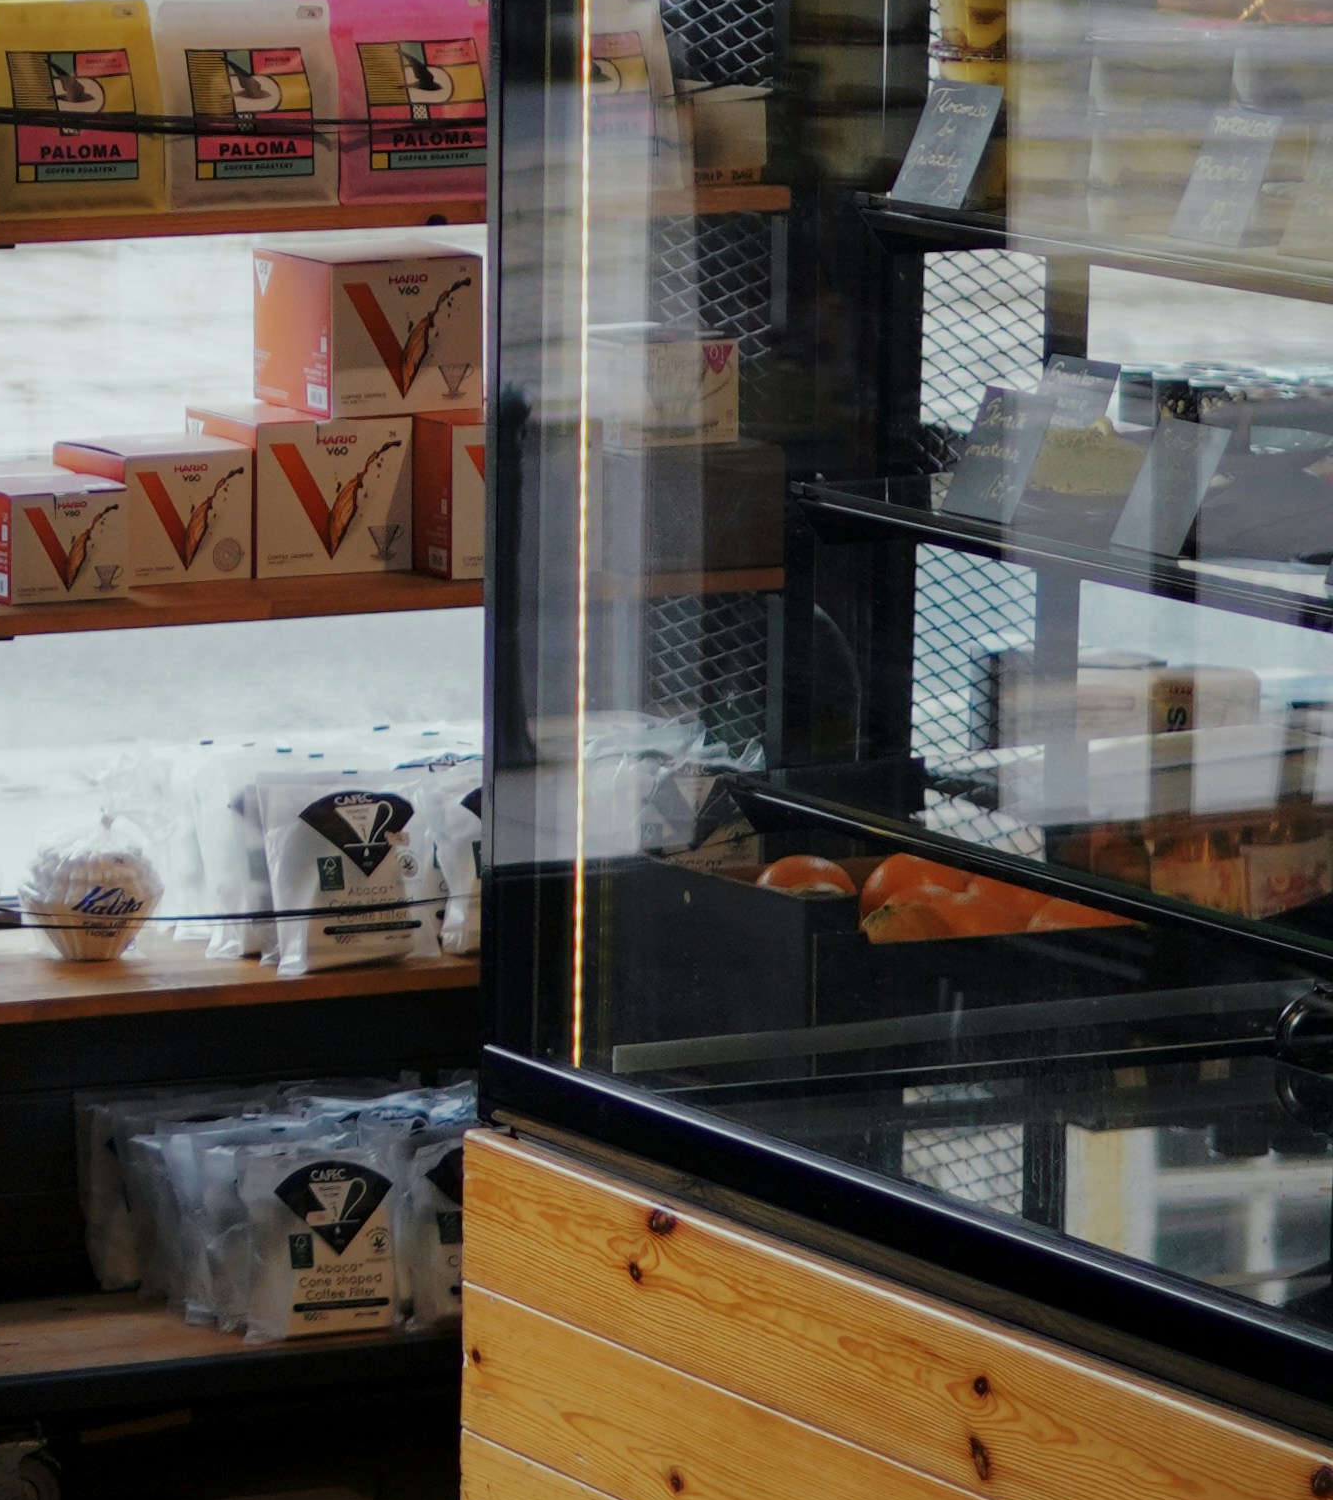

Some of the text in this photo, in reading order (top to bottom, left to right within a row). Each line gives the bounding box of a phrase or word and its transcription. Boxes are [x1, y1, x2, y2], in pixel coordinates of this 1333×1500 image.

[392, 130, 474, 147] PALOMA
[40, 143, 123, 160] PALOMA
[218, 140, 298, 156] PALOMA
[388, 273, 429, 284] HARIO
[397, 285, 421, 296] V60
[316, 434, 358, 446] HARIO
[325, 445, 349, 457] V60
[173, 463, 209, 473] HARIO
[181, 473, 202, 483] V60
[57, 500, 88, 510] HARIO
[333, 793, 374, 806] CAFEC
[71, 885, 146, 916] Kalita
[309, 1167, 348, 1182] CAFEC
[316, 1262, 364, 1274] Abaca+
[298, 1272, 383, 1289] Cone shaped
[305, 1286, 376, 1301] Coffee Filter
